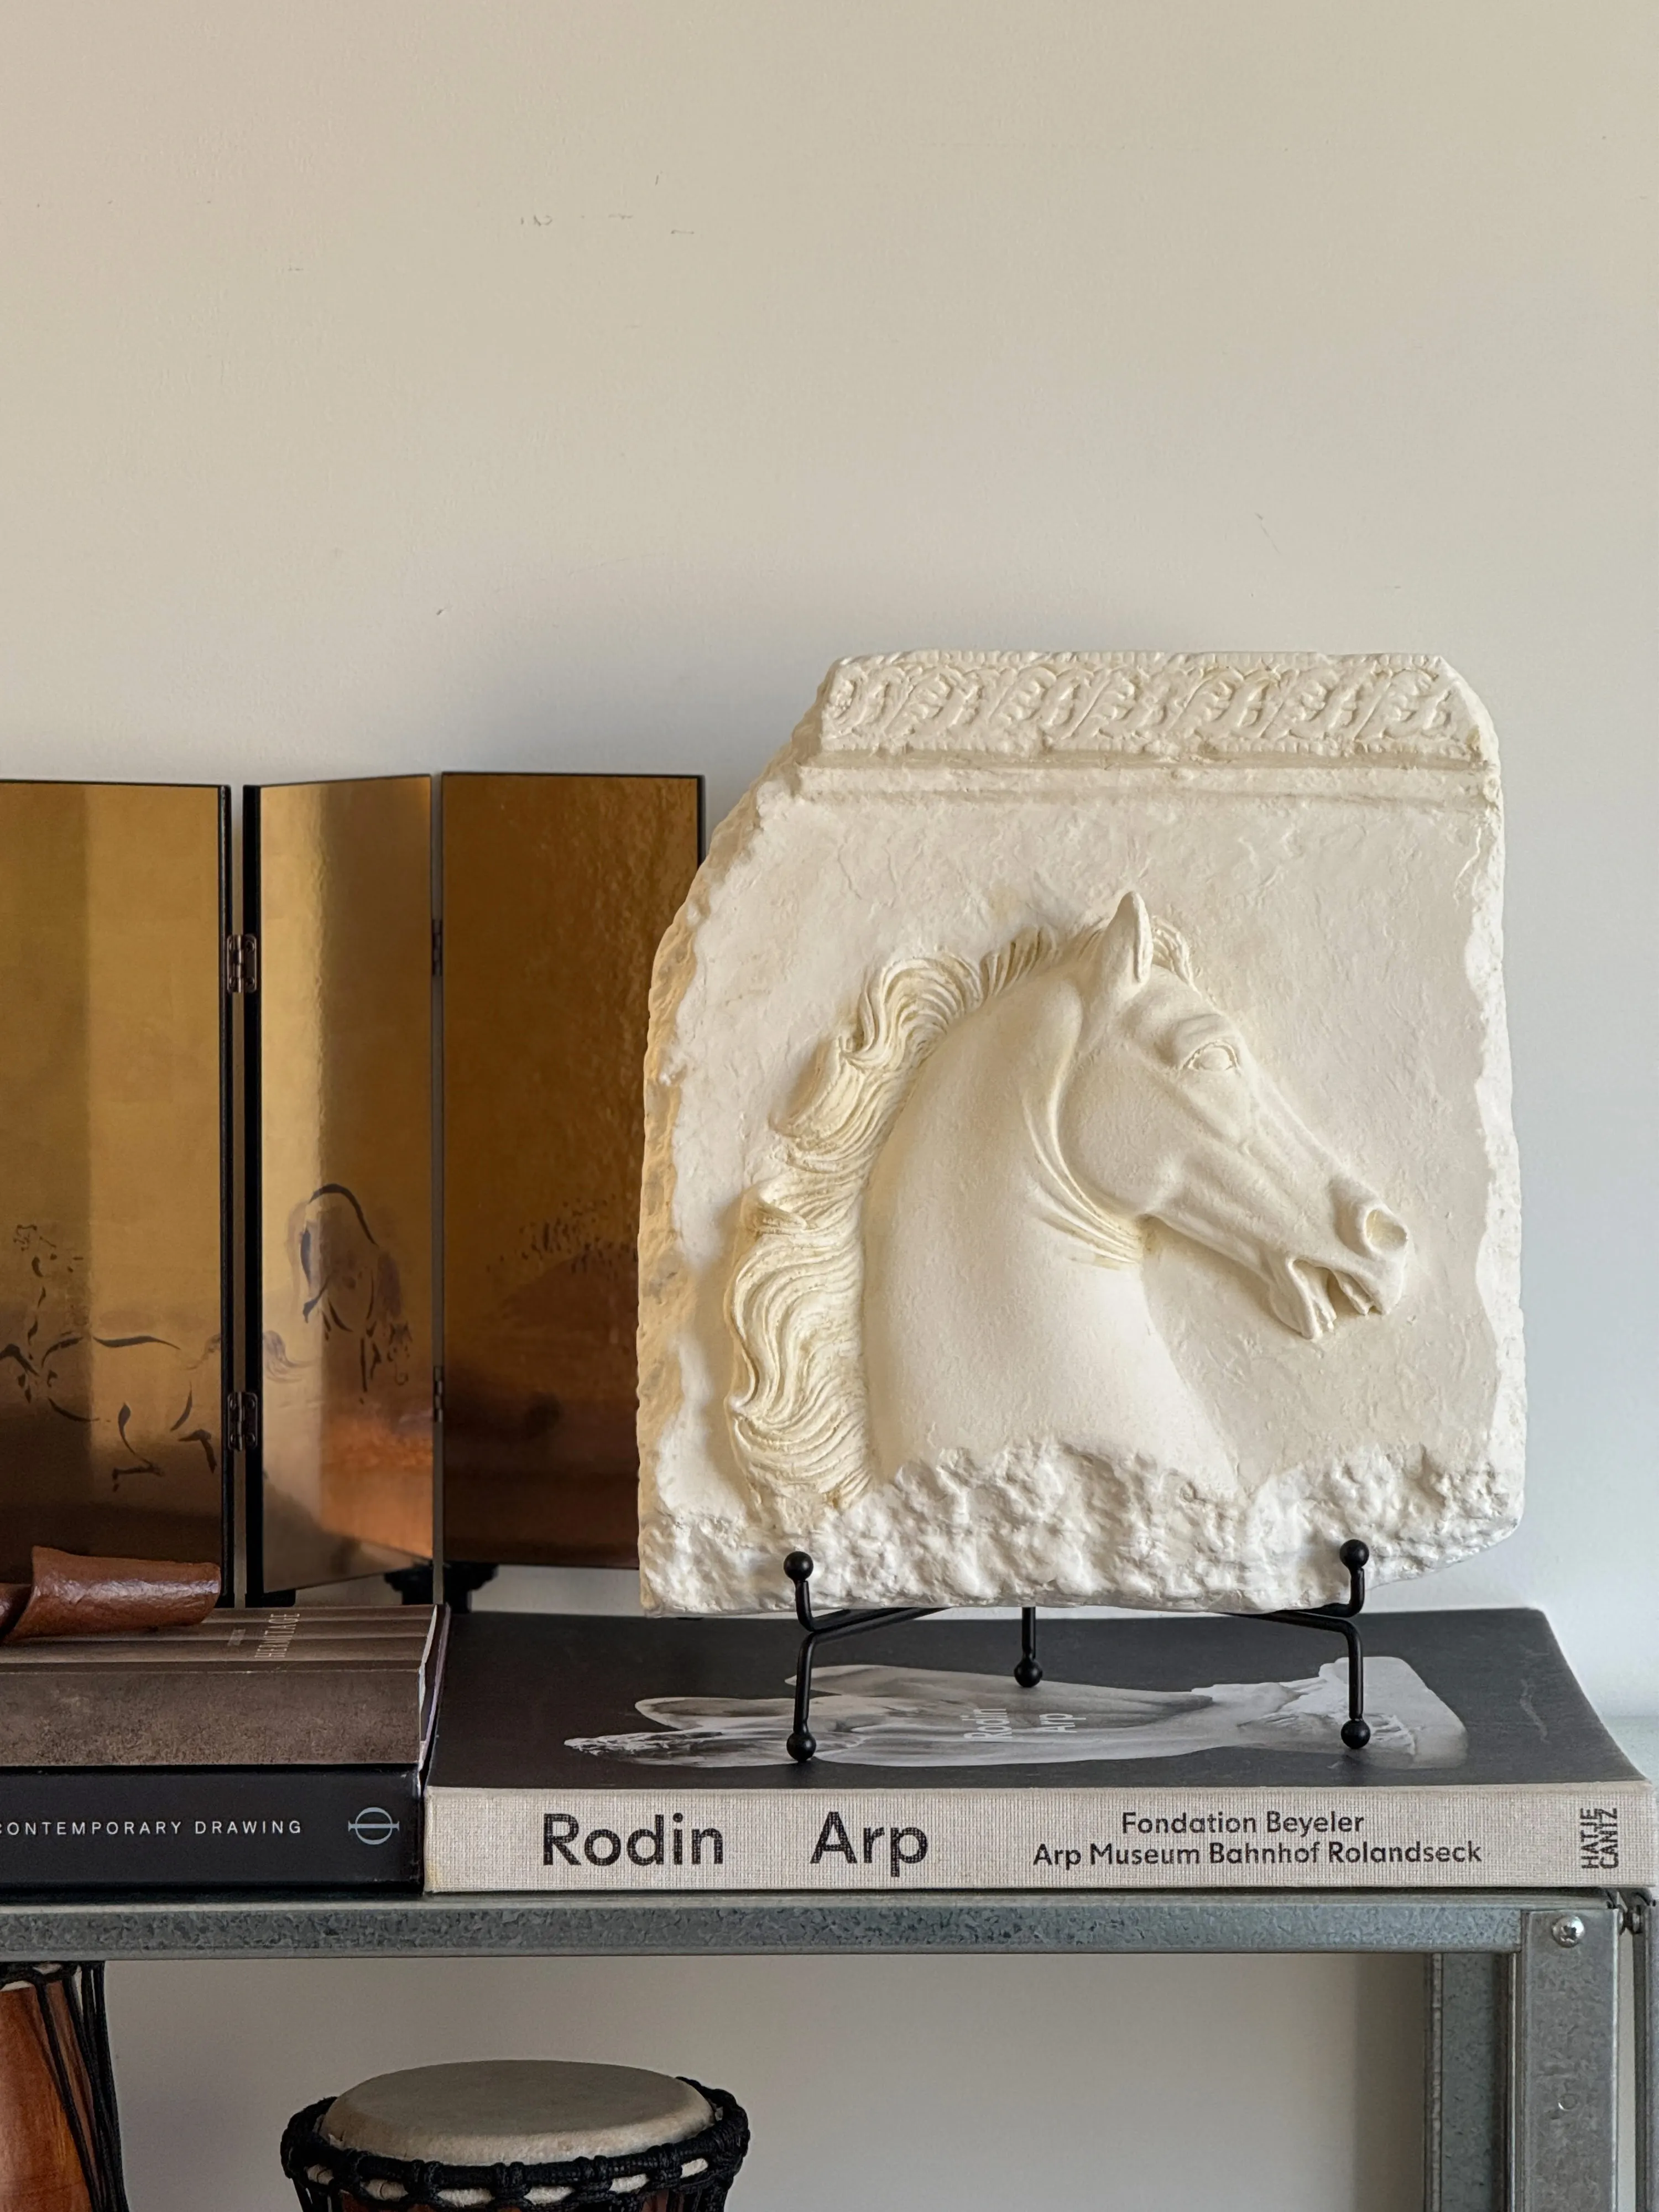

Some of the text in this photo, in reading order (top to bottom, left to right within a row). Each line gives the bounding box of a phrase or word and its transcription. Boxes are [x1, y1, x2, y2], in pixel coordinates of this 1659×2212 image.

[254, 1613, 300, 1658] HERMITAGE
[959, 1708, 1013, 1739] Rodin
[1032, 1713, 1087, 1733] Arp
[0, 1819, 301, 1836] ONTEMPORARY DRAWING
[1121, 1810, 1365, 1838] Fondation Beyeler
[1579, 1808, 1600, 1869] HATJE
[1597, 1808, 1619, 1869] CANTZ
[542, 1811, 928, 1877] Rodin Arp
[1032, 1840, 1483, 1866] Arp Museum Bahnhof Rolandseck
